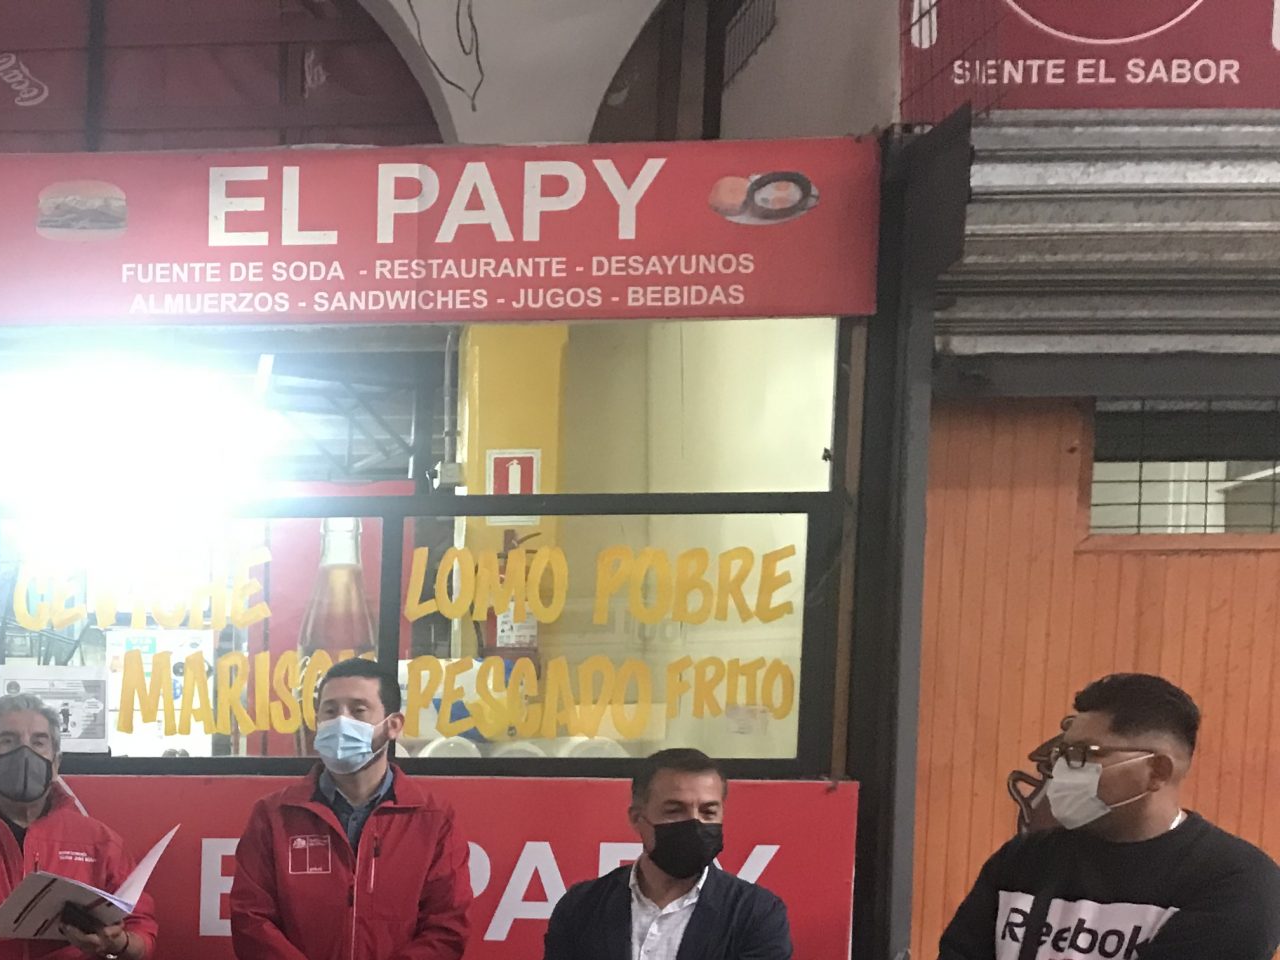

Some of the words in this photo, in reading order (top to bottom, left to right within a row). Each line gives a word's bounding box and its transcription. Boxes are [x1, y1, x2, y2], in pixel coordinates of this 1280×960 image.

[952, 58, 1066, 84] SIENTE
[1076, 59, 1116, 84] EL
[1125, 58, 1240, 84] SABOR
[207, 165, 338, 247] EL
[376, 158, 667, 245] PAPY
[121, 262, 222, 284] FUENTE
[229, 262, 264, 283] DE
[271, 260, 345, 282] SODA
[374, 256, 568, 281] RESTAURANTE
[591, 252, 755, 277] DESAYUNOS
[128, 291, 290, 315] ALMUERZOS
[313, 288, 489, 313] SANDWICHES
[511, 286, 603, 309] JUGOS
[626, 284, 745, 307] BEBIDAS
[403, 545, 569, 624] LOMO
[592, 543, 797, 625] POBRE
[403, 654, 654, 742] PESCADO
[666, 654, 796, 722] FRITO
